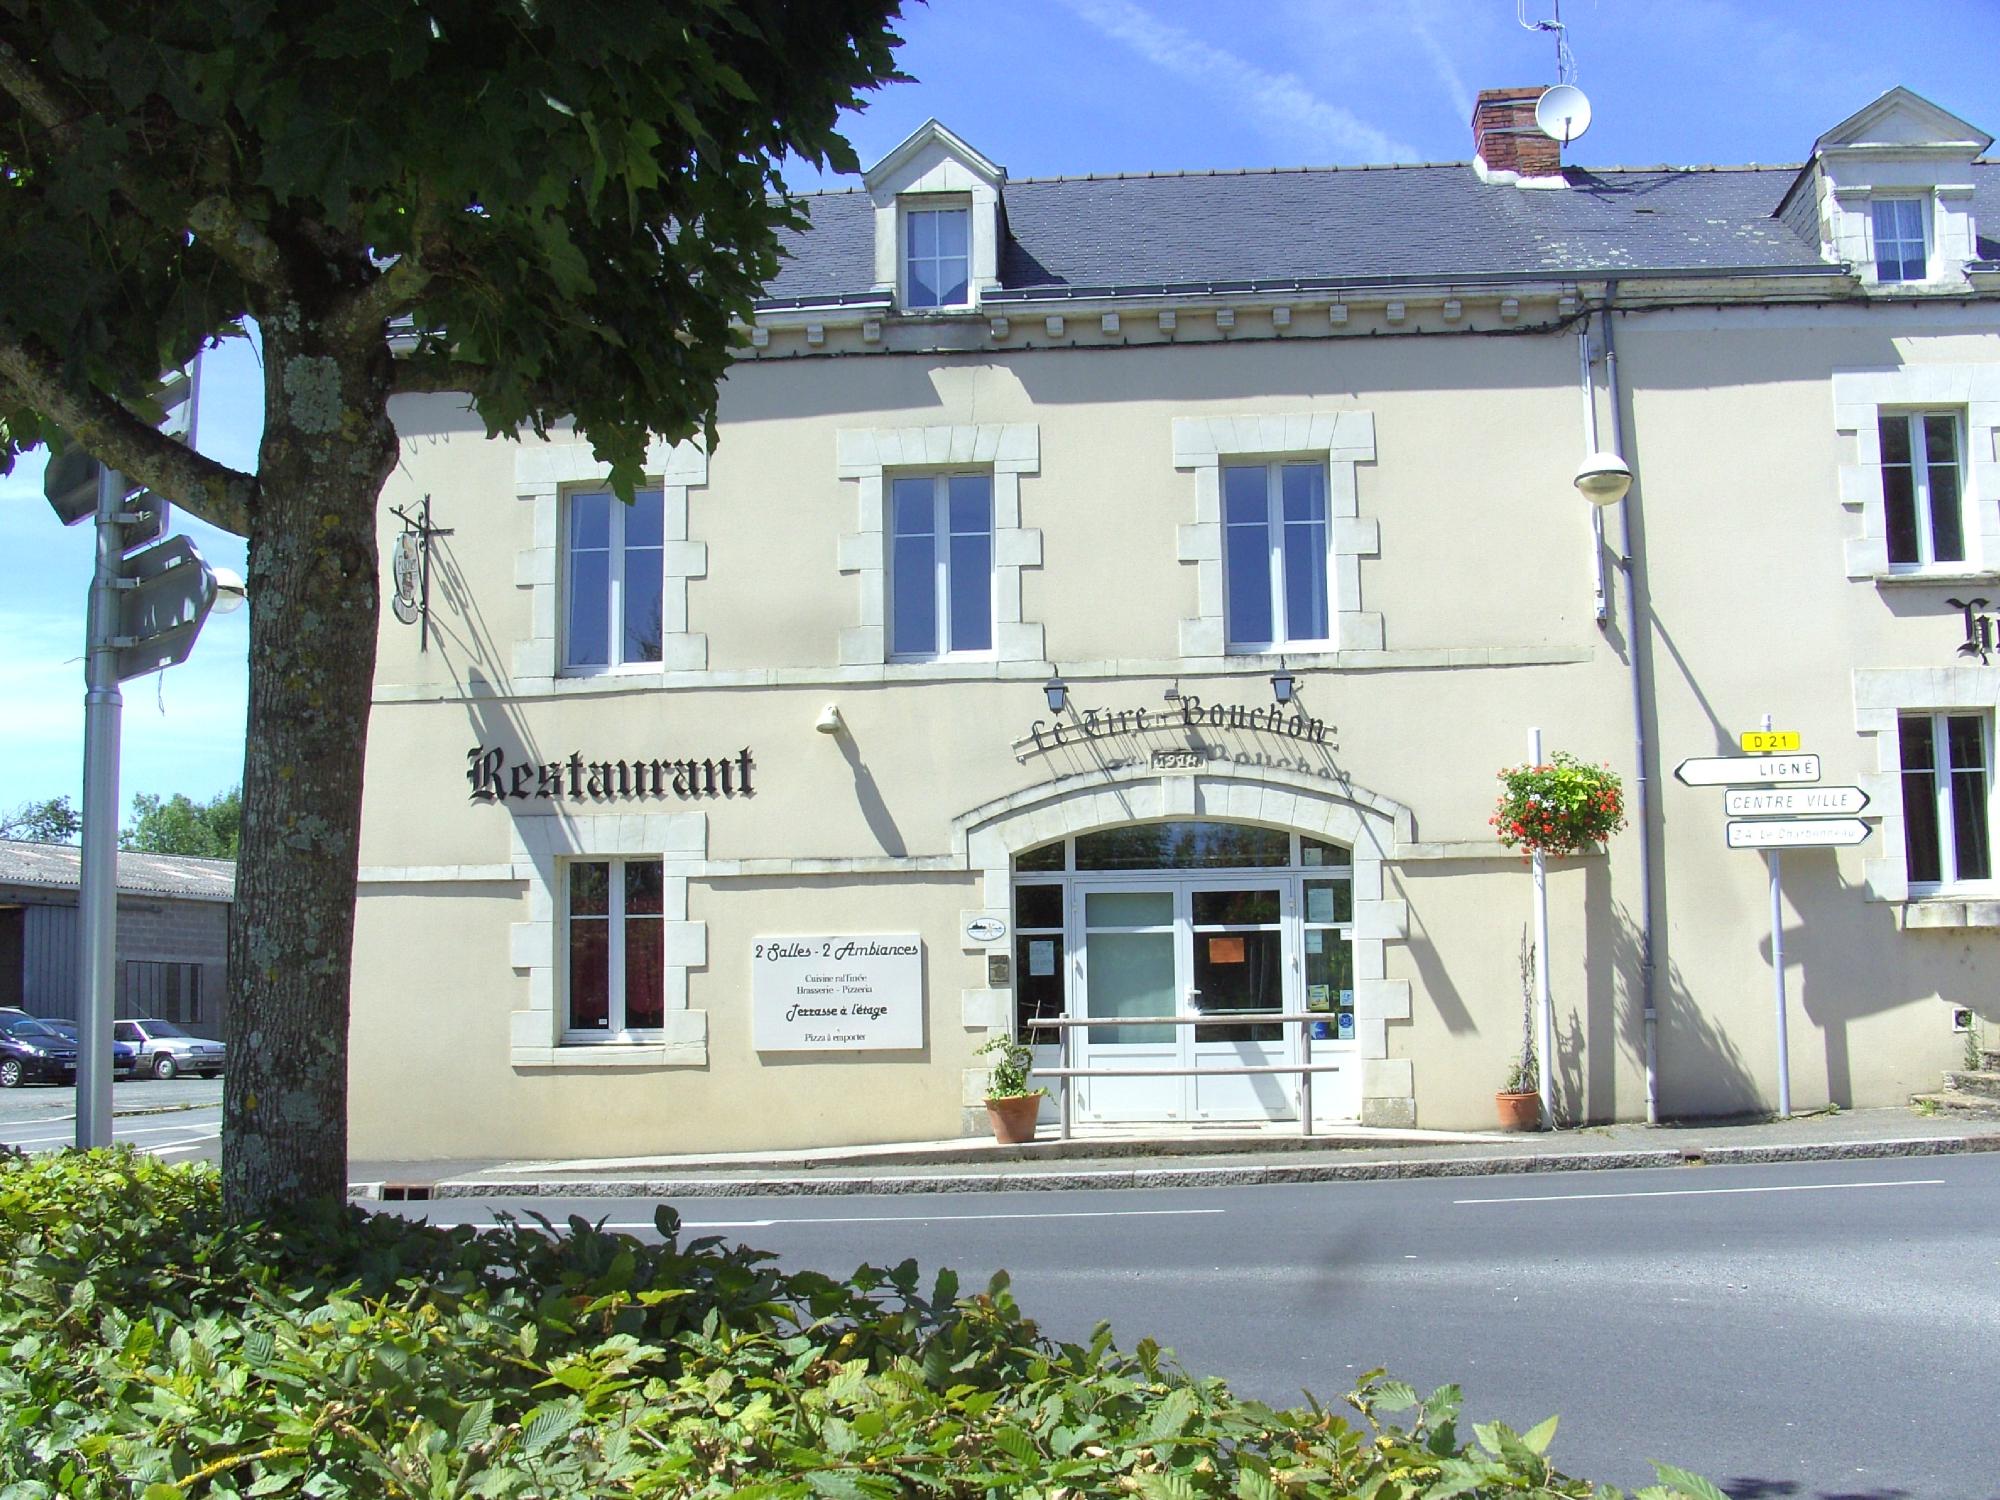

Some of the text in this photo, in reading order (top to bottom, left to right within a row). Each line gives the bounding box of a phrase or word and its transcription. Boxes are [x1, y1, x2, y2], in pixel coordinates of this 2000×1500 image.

[1031, 695, 1325, 750] Le Tire Bouchon
[1754, 735, 1787, 748] D 21
[467, 744, 754, 800] Restaurant
[1733, 794, 1848, 809] CENTRE VILLE
[755, 944, 764, 958] 2
[767, 943, 812, 961] Salles
[822, 943, 831, 957] 2
[834, 941, 919, 960] Ambiances
[804, 974, 834, 983] Cuisine
[796, 986, 834, 995] Brasserie
[842, 985, 873, 994] Pizzeria
[785, 1003, 838, 1022] Terrasse
[851, 1003, 888, 1020] l'étage
[804, 1033, 826, 1042] Pizza
[832, 1034, 866, 1043] emporter
